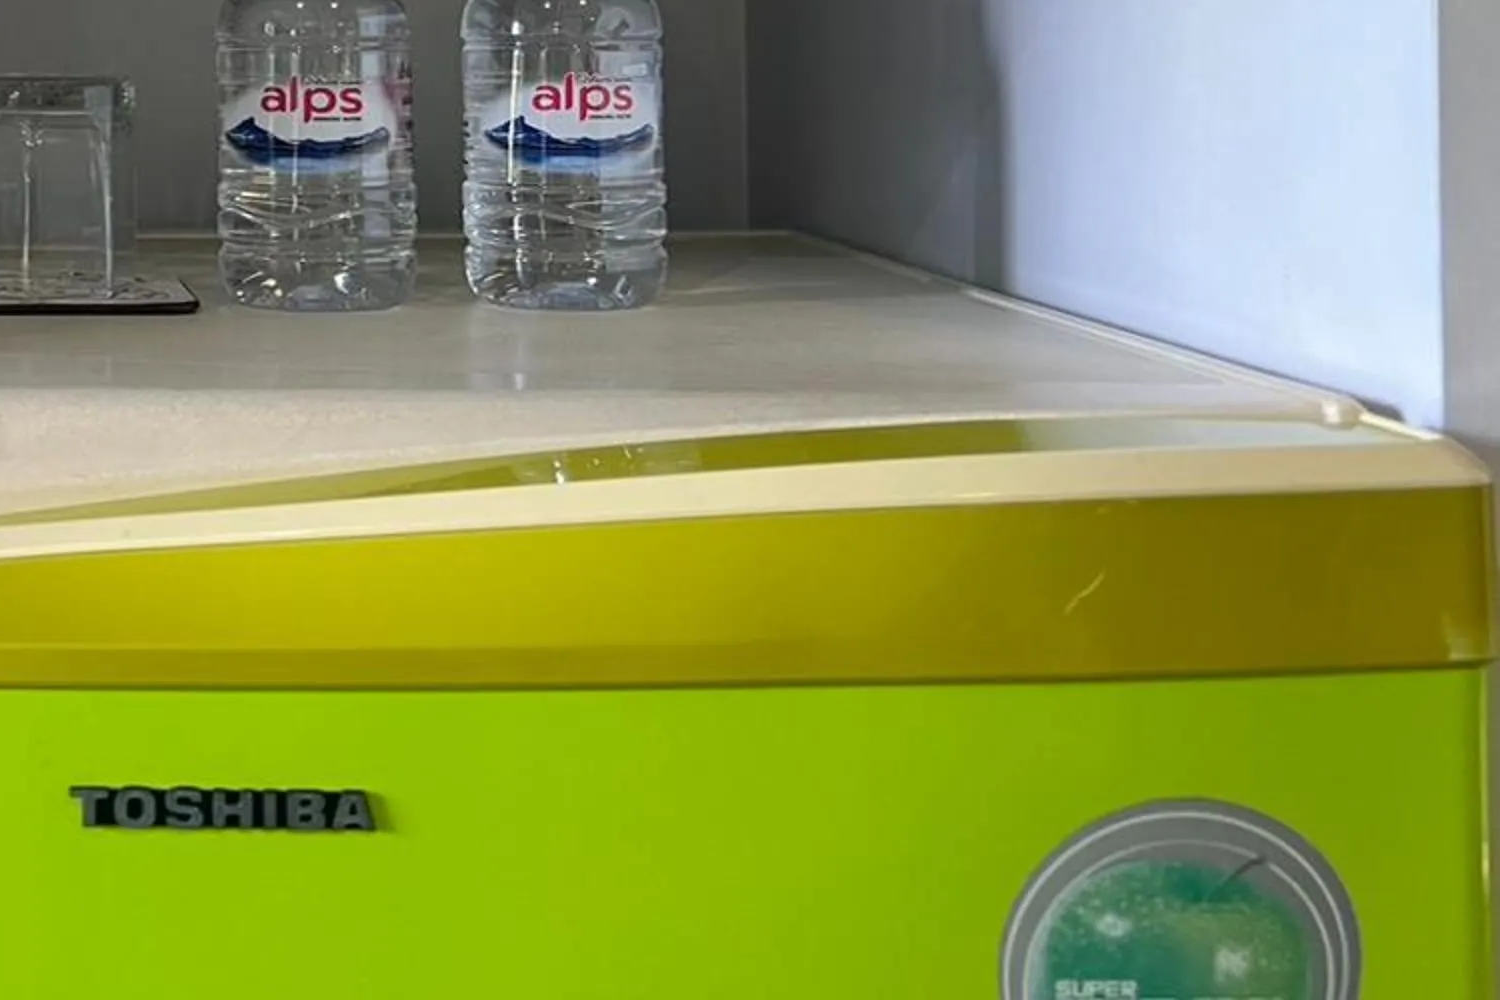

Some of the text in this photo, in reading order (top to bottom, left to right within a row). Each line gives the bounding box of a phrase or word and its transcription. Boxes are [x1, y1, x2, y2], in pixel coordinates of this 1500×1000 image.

[260, 76, 363, 123] alps
[532, 73, 633, 121] alps
[69, 786, 376, 831] TOSHIBA
[1054, 979, 1137, 998] SUPER
